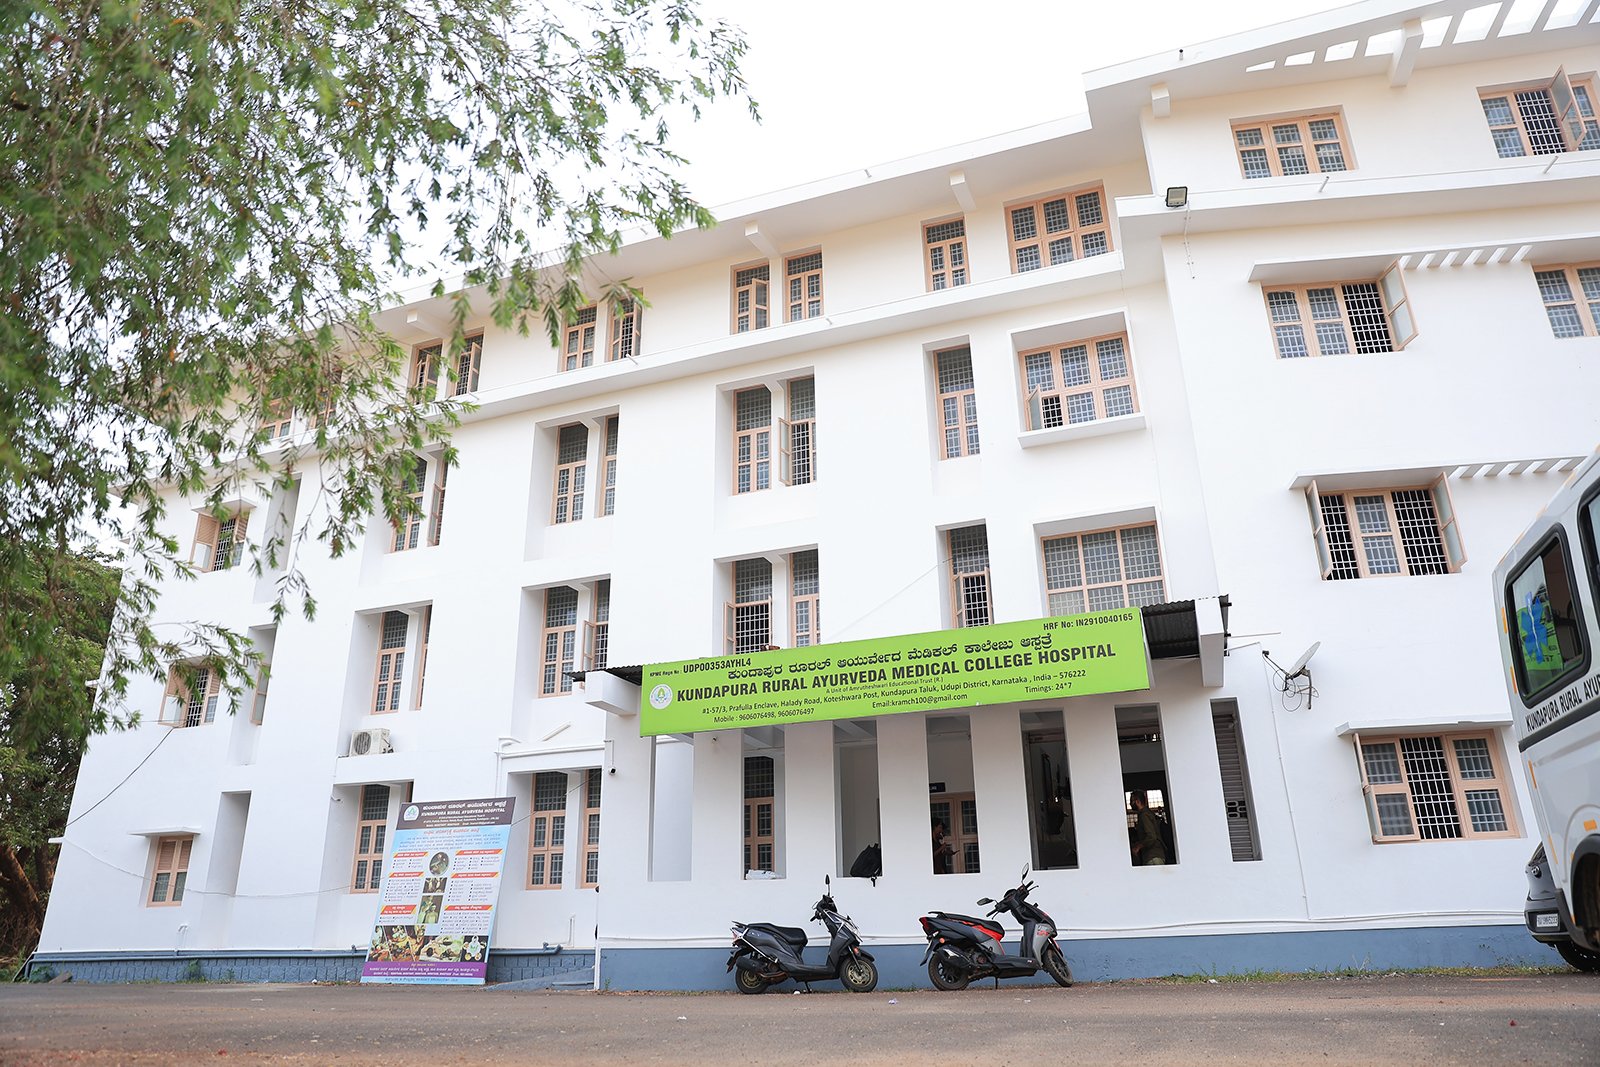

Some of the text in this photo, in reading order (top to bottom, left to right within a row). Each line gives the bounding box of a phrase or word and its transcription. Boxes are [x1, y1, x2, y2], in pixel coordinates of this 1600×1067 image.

[1043, 613, 1134, 631] HRF No: IN2910040165
[677, 643, 1116, 702] KUNDAPURA RURAL AYURVEDA MEDICAL COLLEGE HOSPITAL
[683, 658, 752, 674] UDP00353AYHL4
[729, 703, 753, 712] Prafulla
[781, 699, 803, 708] Halady
[803, 696, 822, 705] Road,
[823, 693, 862, 703] Koteshwara
[863, 691, 880, 699] Post,
[881, 687, 918, 698] Kundapura
[919, 685, 939, 694] Taluk,
[941, 682, 962, 692] Udupi
[963, 679, 990, 689] District,
[992, 676, 1028, 686] Karnataka
[1033, 674, 1052, 682] India
[1060, 670, 1086, 679] 576222
[1025, 685, 1054, 693] Timings:
[872, 693, 968, 709] Email:kramch100@gmail.com
[1525, 700, 1560, 732] KUNDAPURA
[1560, 686, 1582, 714] RURAL
